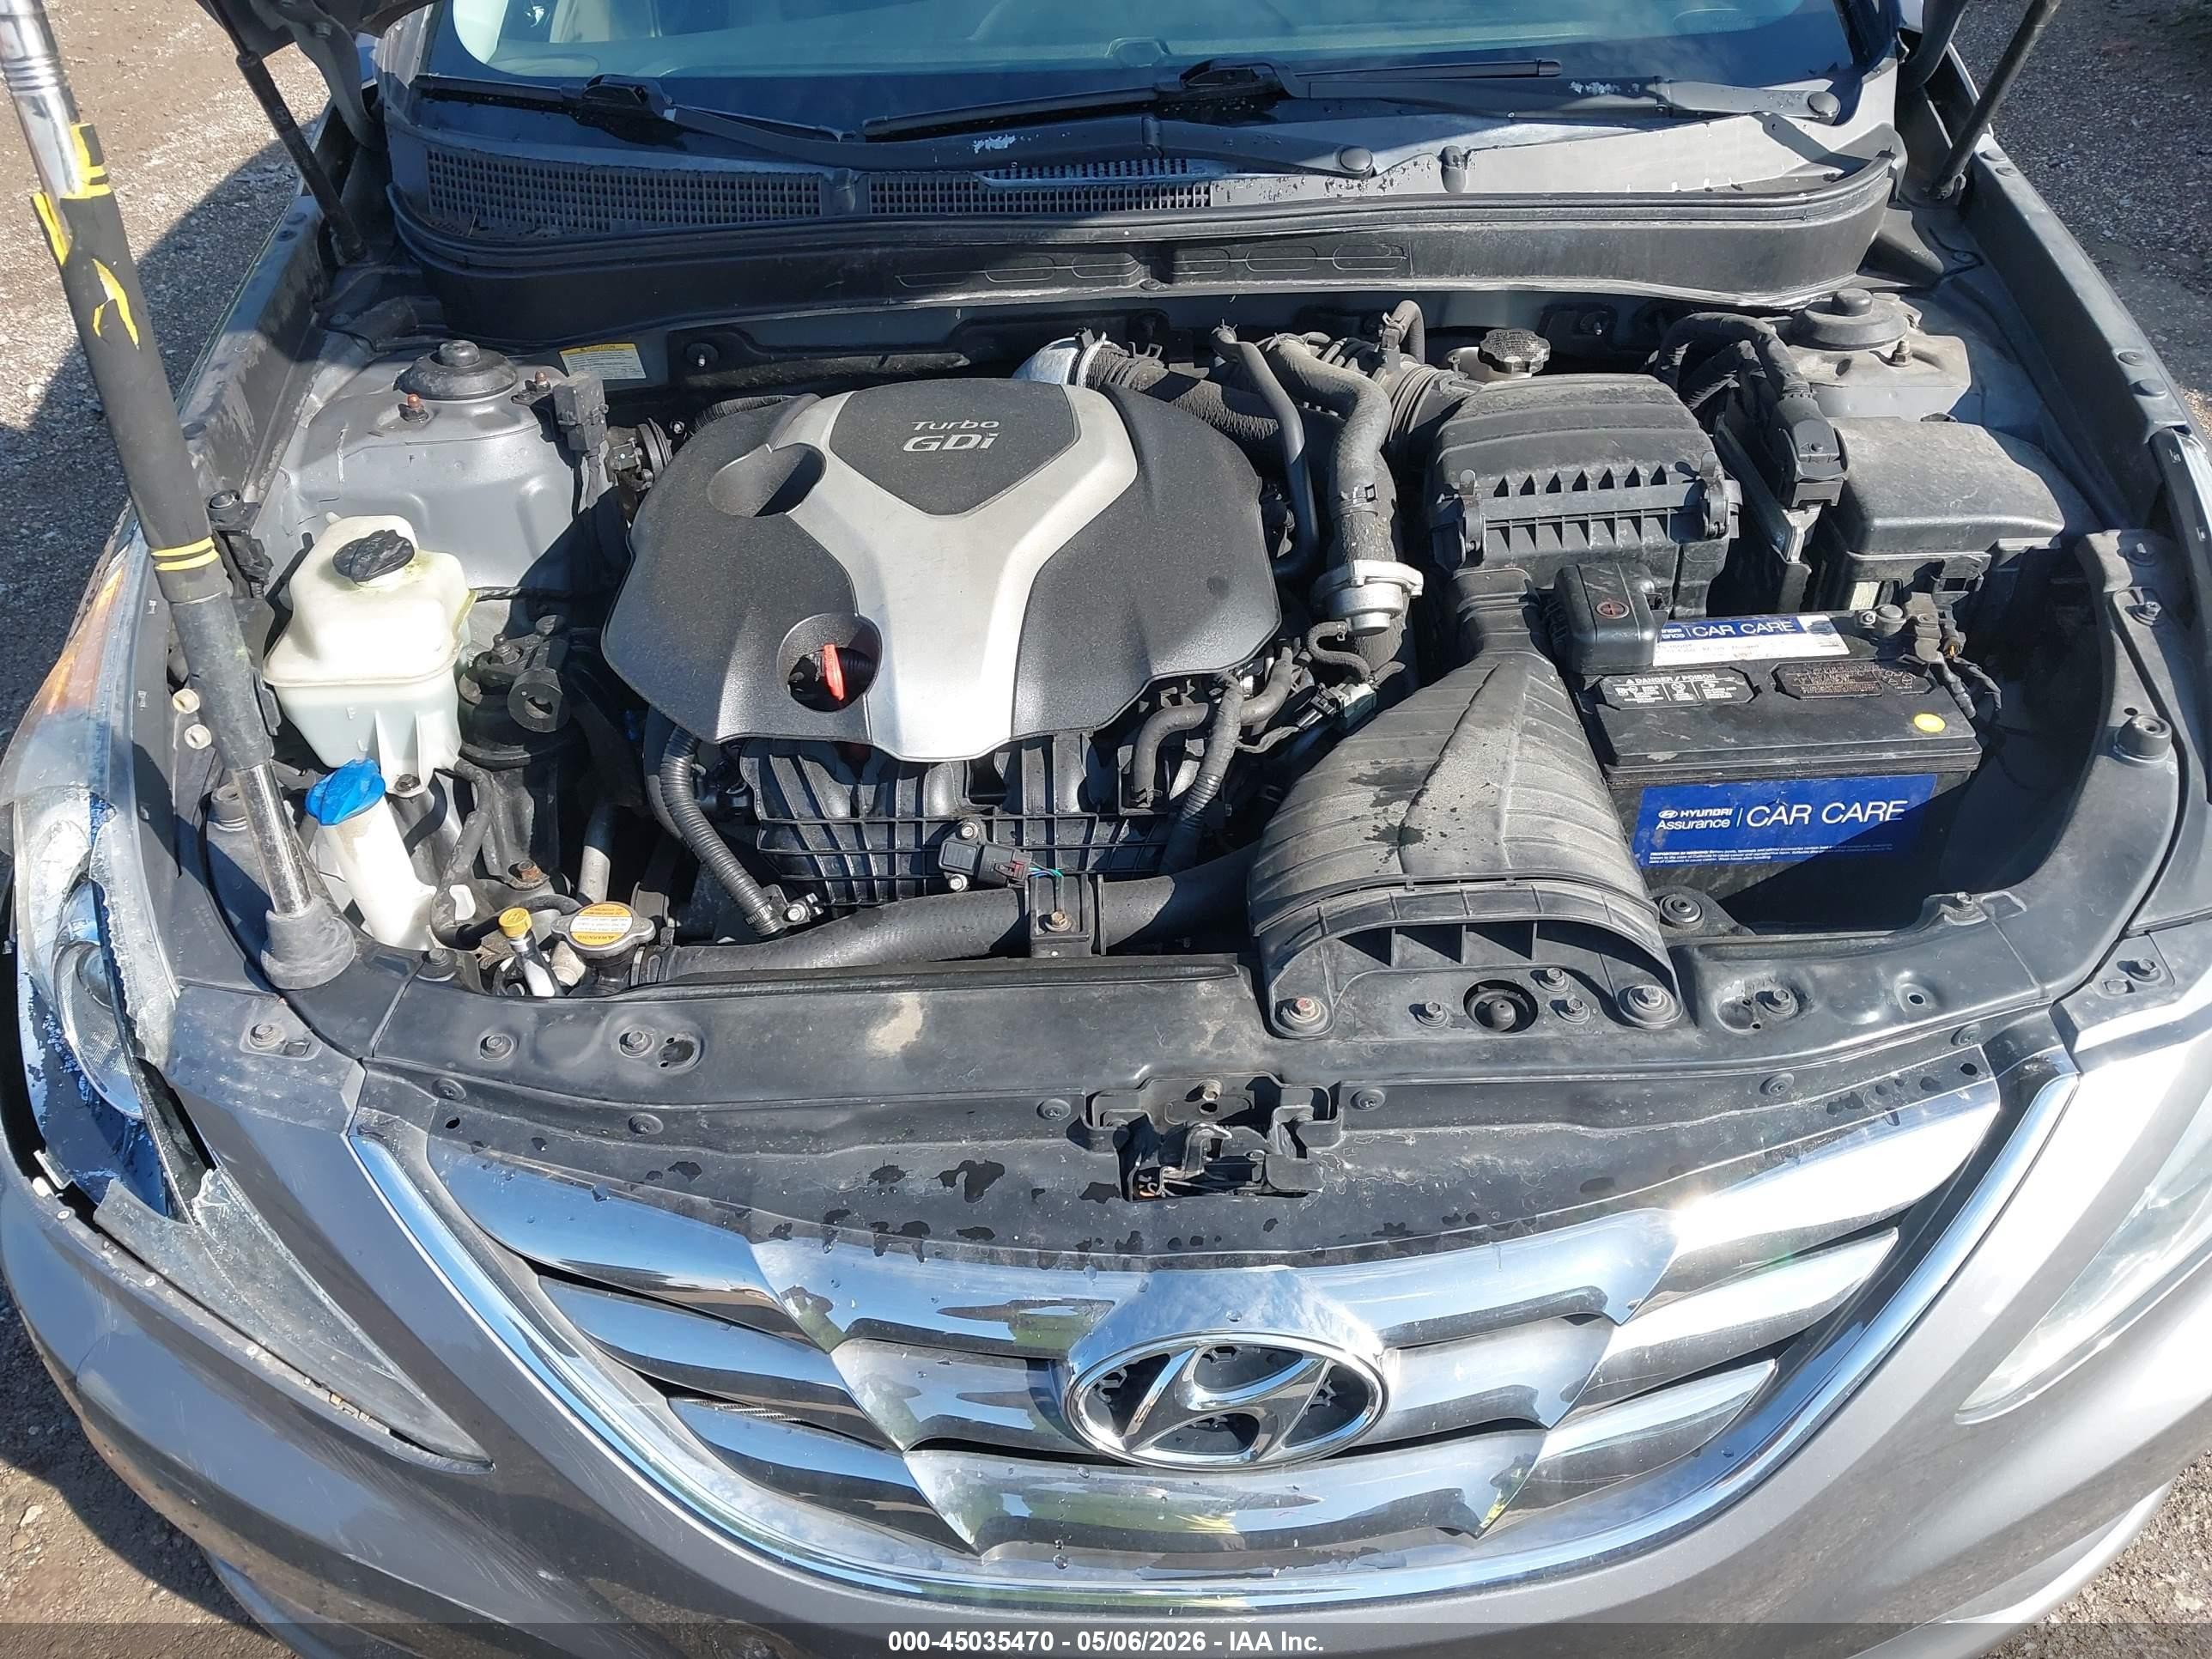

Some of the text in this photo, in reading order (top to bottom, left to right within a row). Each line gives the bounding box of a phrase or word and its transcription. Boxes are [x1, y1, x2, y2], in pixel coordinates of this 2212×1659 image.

[911, 420, 1000, 431] Turbo
[902, 432, 1000, 452] GDi
[1692, 626, 1735, 638] CAR
[1741, 621, 1797, 635] CARE
[1634, 676, 1674, 684] DANGER
[1680, 808, 1733, 818] HYUNDAI
[1747, 799, 1908, 828] CAR CARE
[1656, 818, 1731, 831] Assurance
